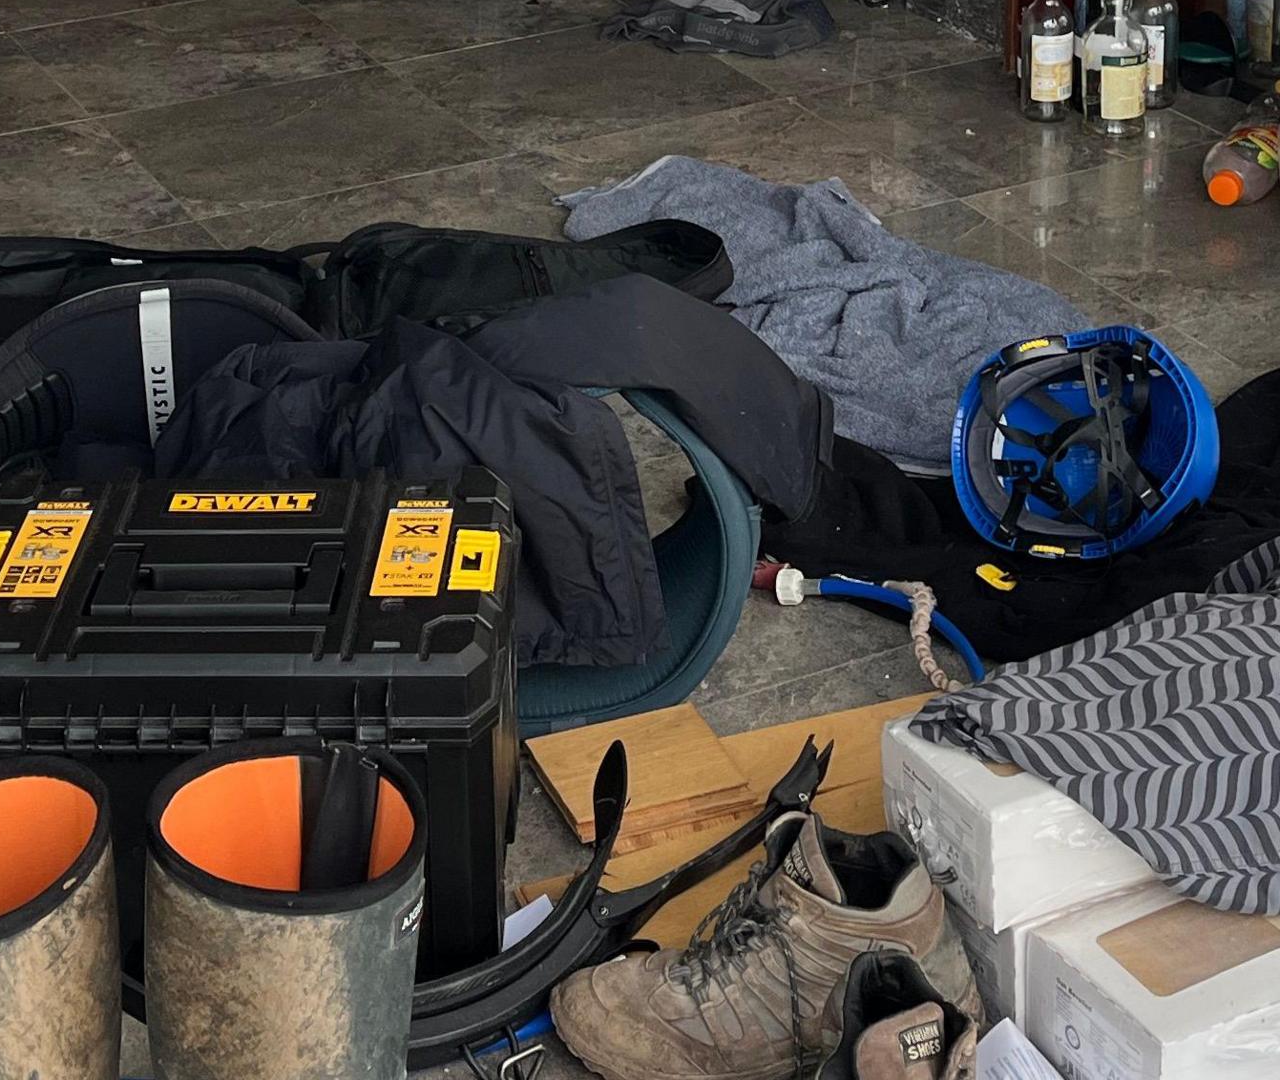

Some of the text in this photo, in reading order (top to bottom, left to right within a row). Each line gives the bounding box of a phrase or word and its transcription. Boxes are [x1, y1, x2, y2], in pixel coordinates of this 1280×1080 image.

[36, 502, 91, 510] DEWALT
[168, 492, 317, 513] DEWALT
[396, 500, 449, 508] DEWALT
[31, 526, 74, 537] XR
[398, 524, 440, 535] XR
[907, 1039, 941, 1060] SHOES
